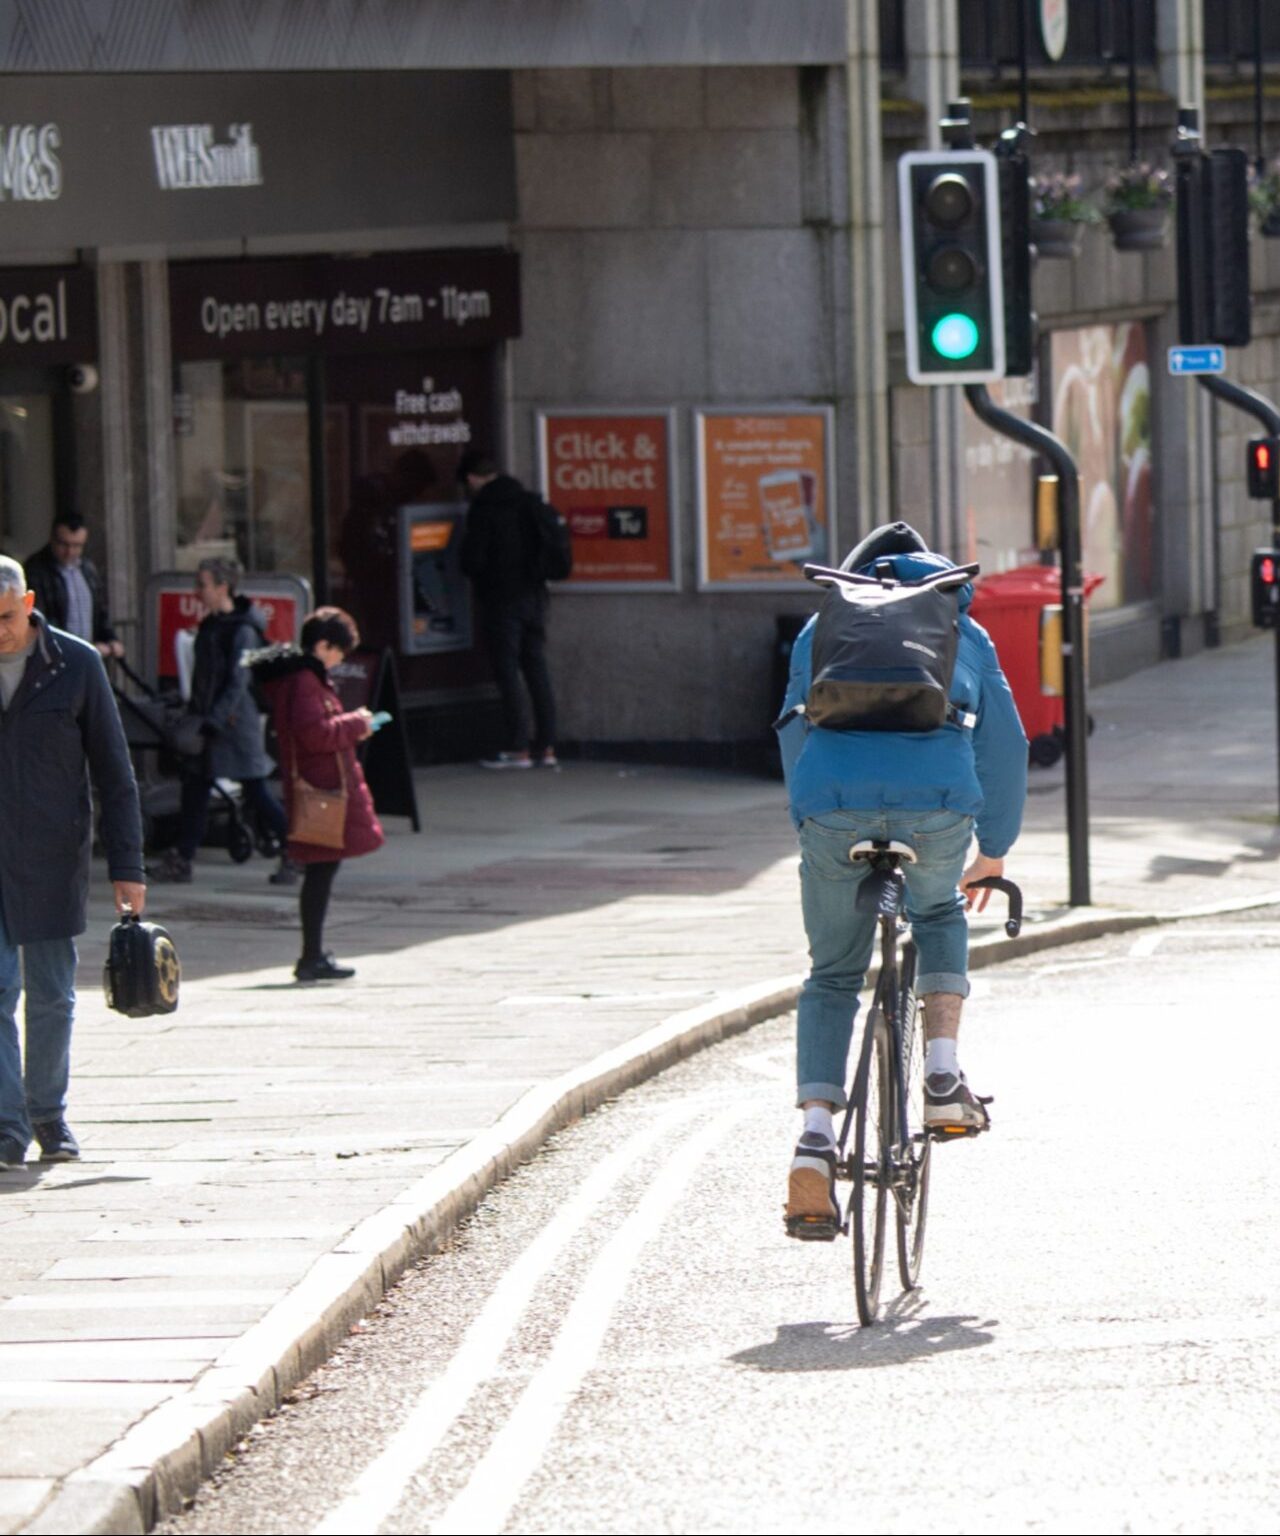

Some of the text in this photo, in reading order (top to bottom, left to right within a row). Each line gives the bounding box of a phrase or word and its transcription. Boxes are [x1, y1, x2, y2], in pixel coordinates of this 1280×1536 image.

[202, 296, 260, 338] Open
[265, 300, 327, 335] every
[332, 290, 371, 333] day
[375, 287, 424, 323] 7am
[440, 285, 491, 326] 11pm
[396, 386, 463, 414] Free cash
[389, 419, 471, 446] withdrawals
[554, 430, 657, 460] Click &
[554, 462, 657, 491] Collect
[614, 510, 642, 534] Tu
